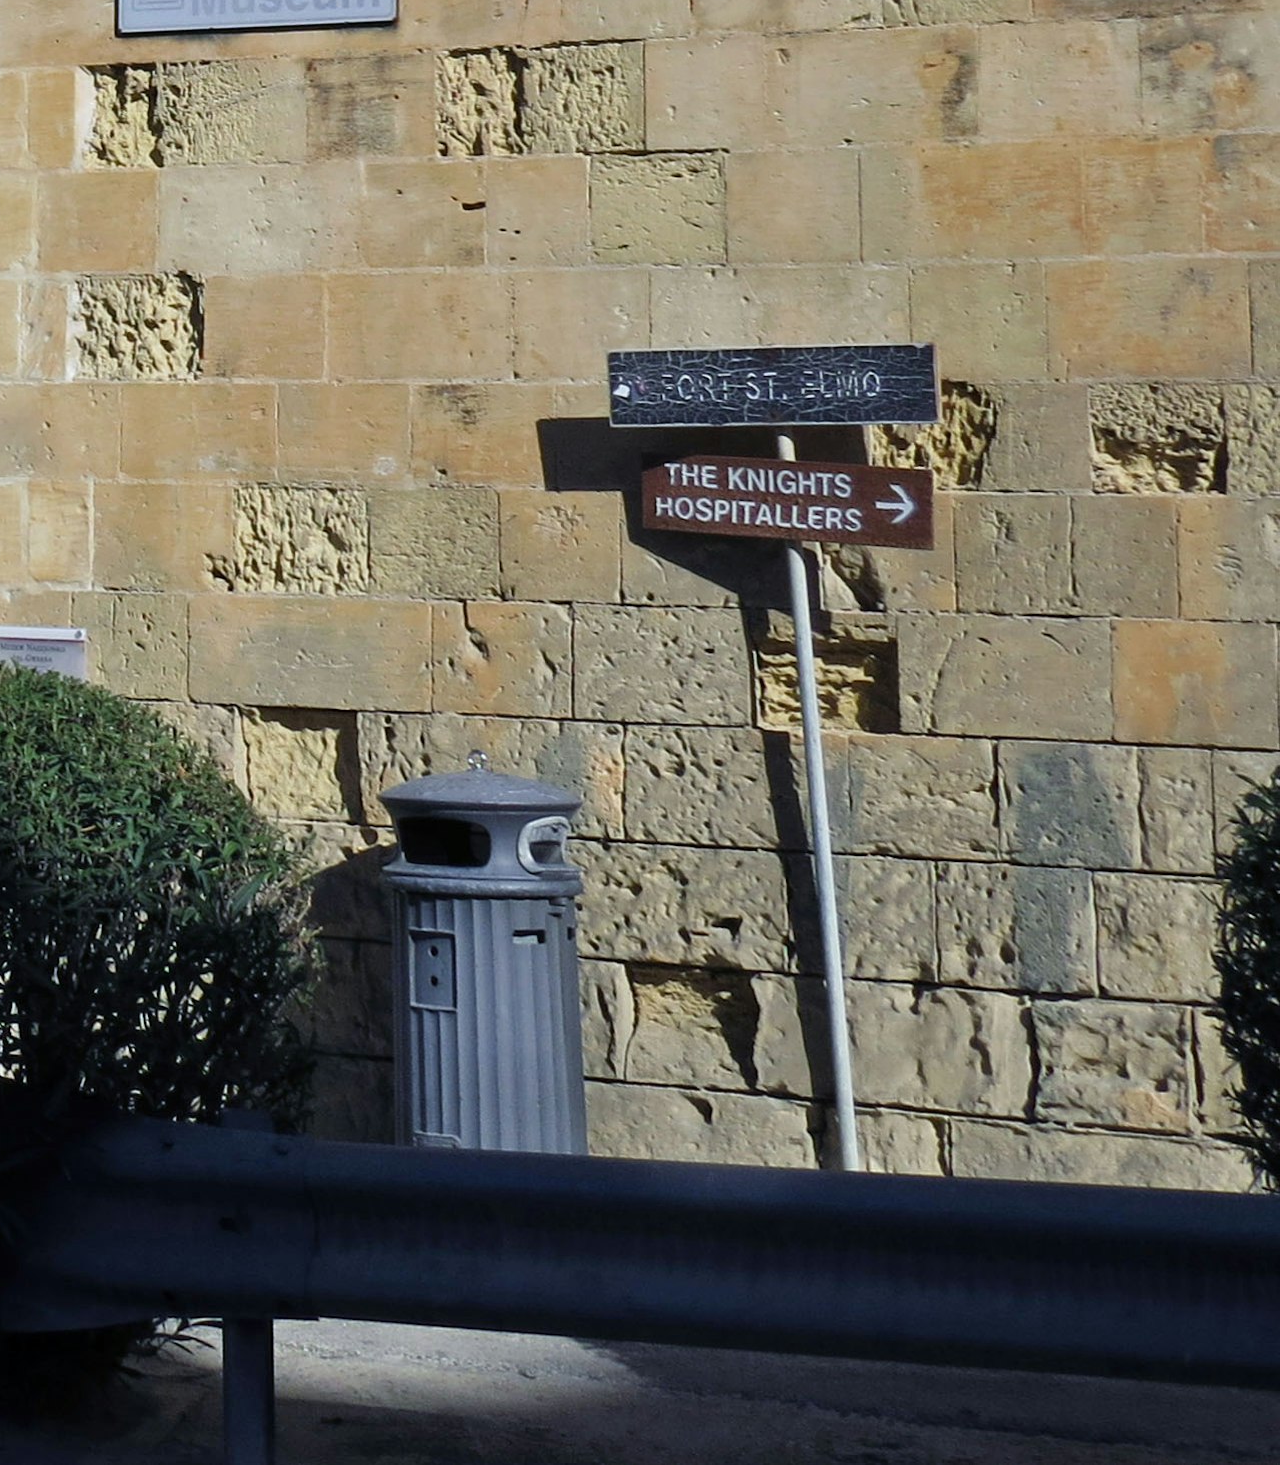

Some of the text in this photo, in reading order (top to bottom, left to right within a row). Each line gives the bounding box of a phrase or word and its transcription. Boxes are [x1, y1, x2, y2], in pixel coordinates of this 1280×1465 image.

[661, 370, 881, 402] FORT ST. ELMO
[664, 462, 852, 498] THE KNIGHTS
[655, 496, 863, 532] HOSPITALLERS
